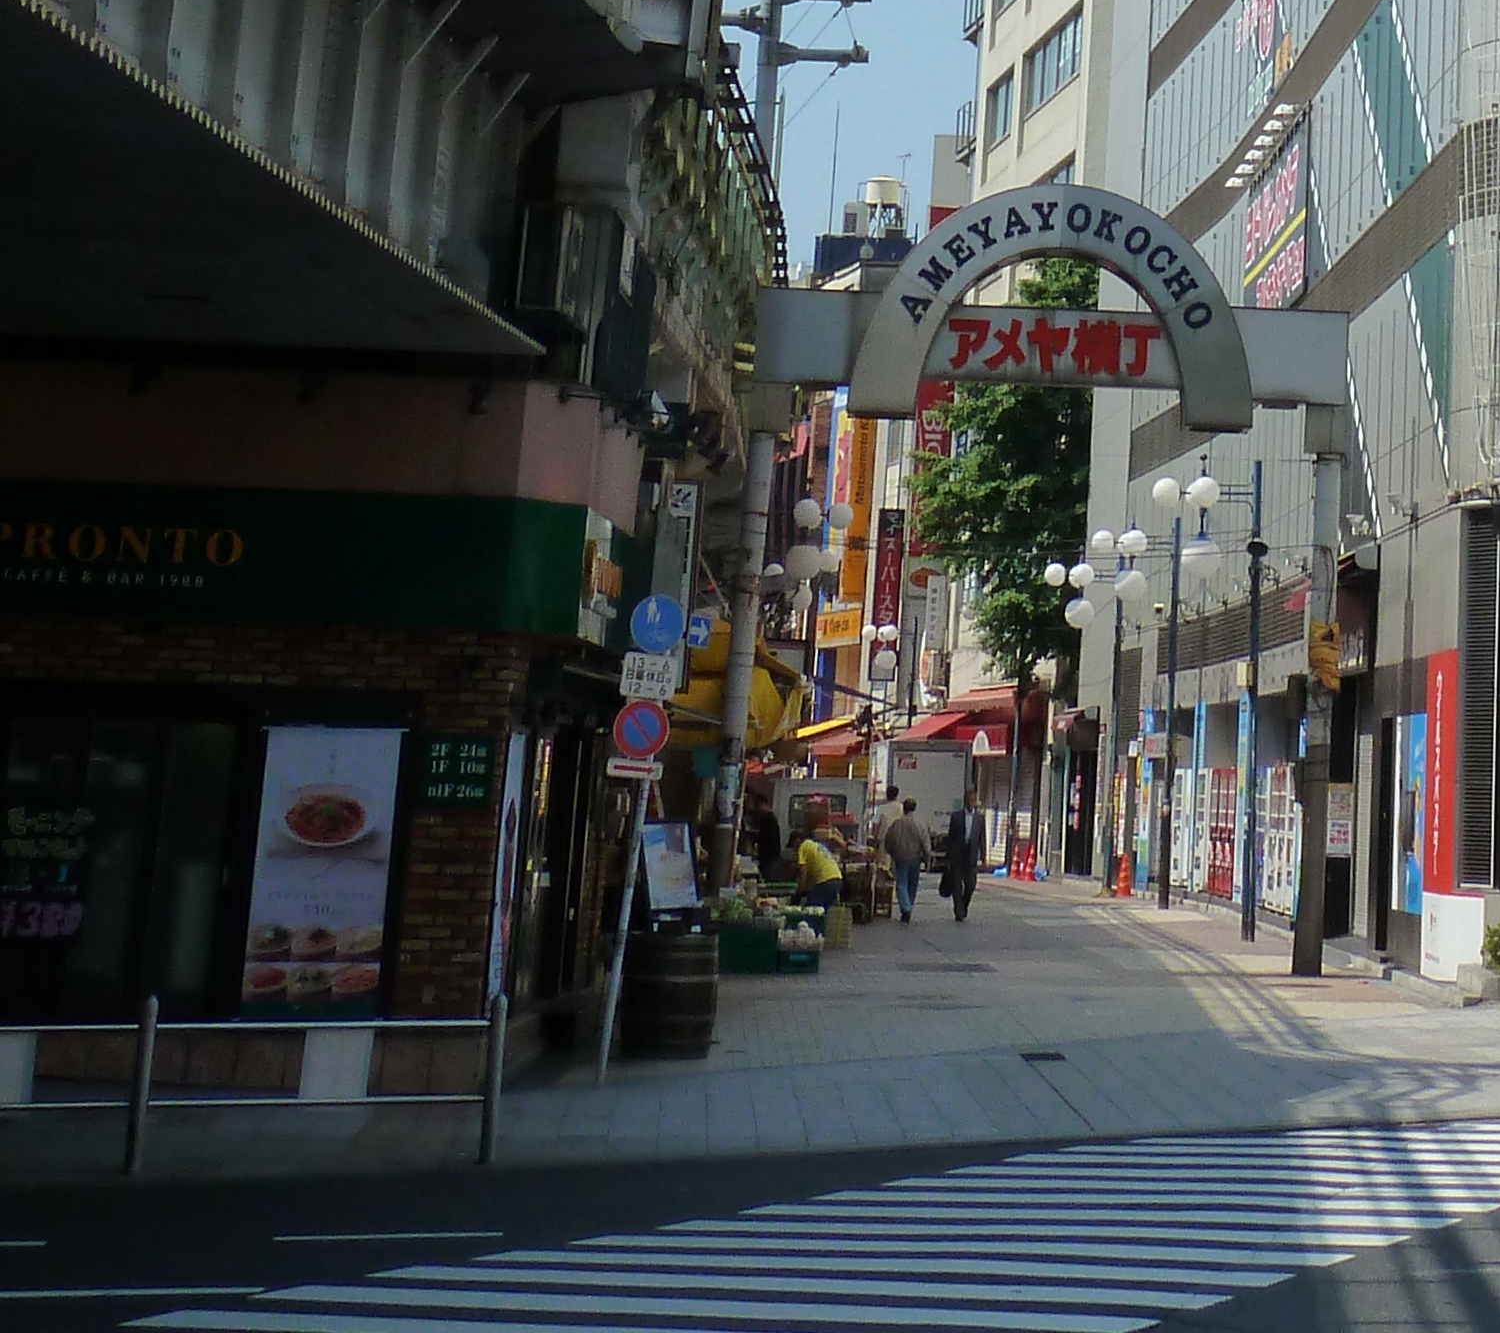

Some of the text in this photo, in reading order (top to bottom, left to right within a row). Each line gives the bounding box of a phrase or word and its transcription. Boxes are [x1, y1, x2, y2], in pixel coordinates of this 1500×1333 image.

[900, 200, 1213, 330] AMEYAYOKOCHO
[948, 316, 1162, 378] アメヤ横丁
[81, 569, 93, 584] &
[106, 572, 146, 586] BAR
[431, 743, 450, 757] 2F
[431, 759, 450, 774] 1F
